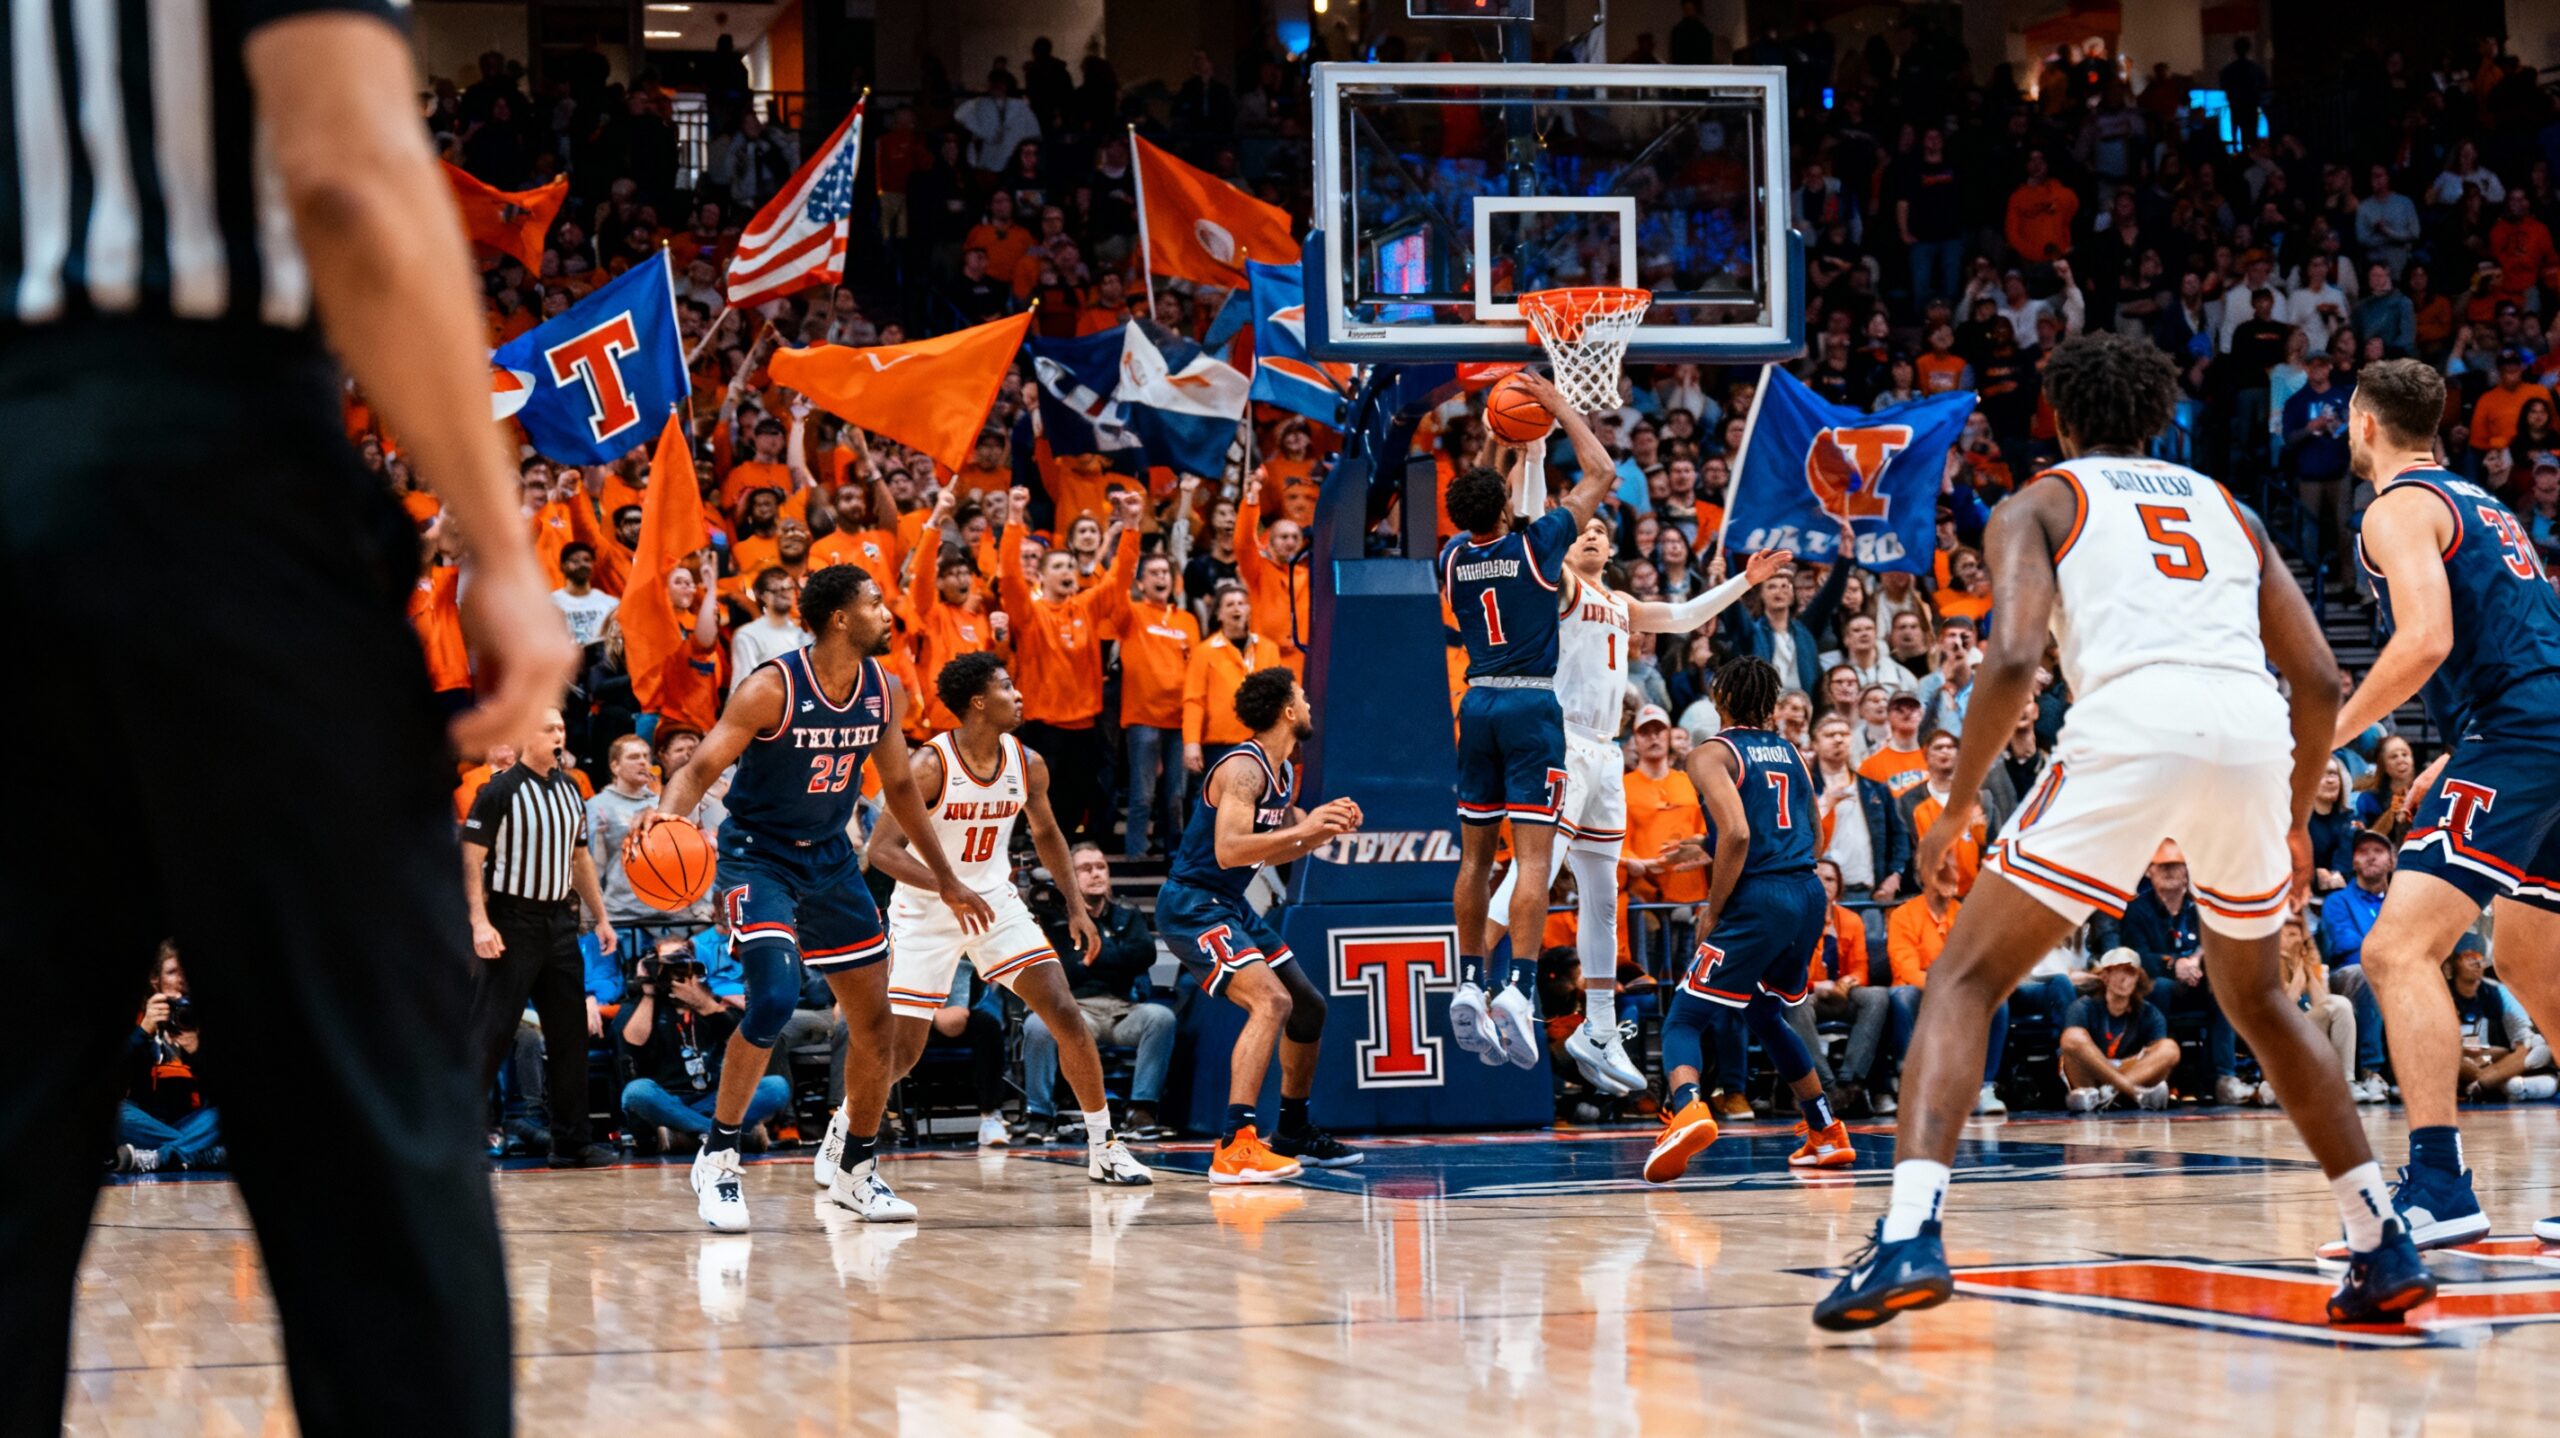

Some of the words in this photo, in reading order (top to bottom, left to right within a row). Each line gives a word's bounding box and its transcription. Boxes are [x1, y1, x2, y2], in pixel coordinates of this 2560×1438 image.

[544, 309, 641, 444] T
[2135, 503, 2209, 581] 5
[1480, 587, 1508, 646] 1
[1607, 633, 1616, 671] 1
[807, 752, 856, 793] 29
[1765, 770, 1792, 829] 7
[2438, 778, 2497, 841] T
[961, 826, 998, 862] 10
[1197, 924, 1234, 963] T
[1327, 925, 1461, 1090] T
